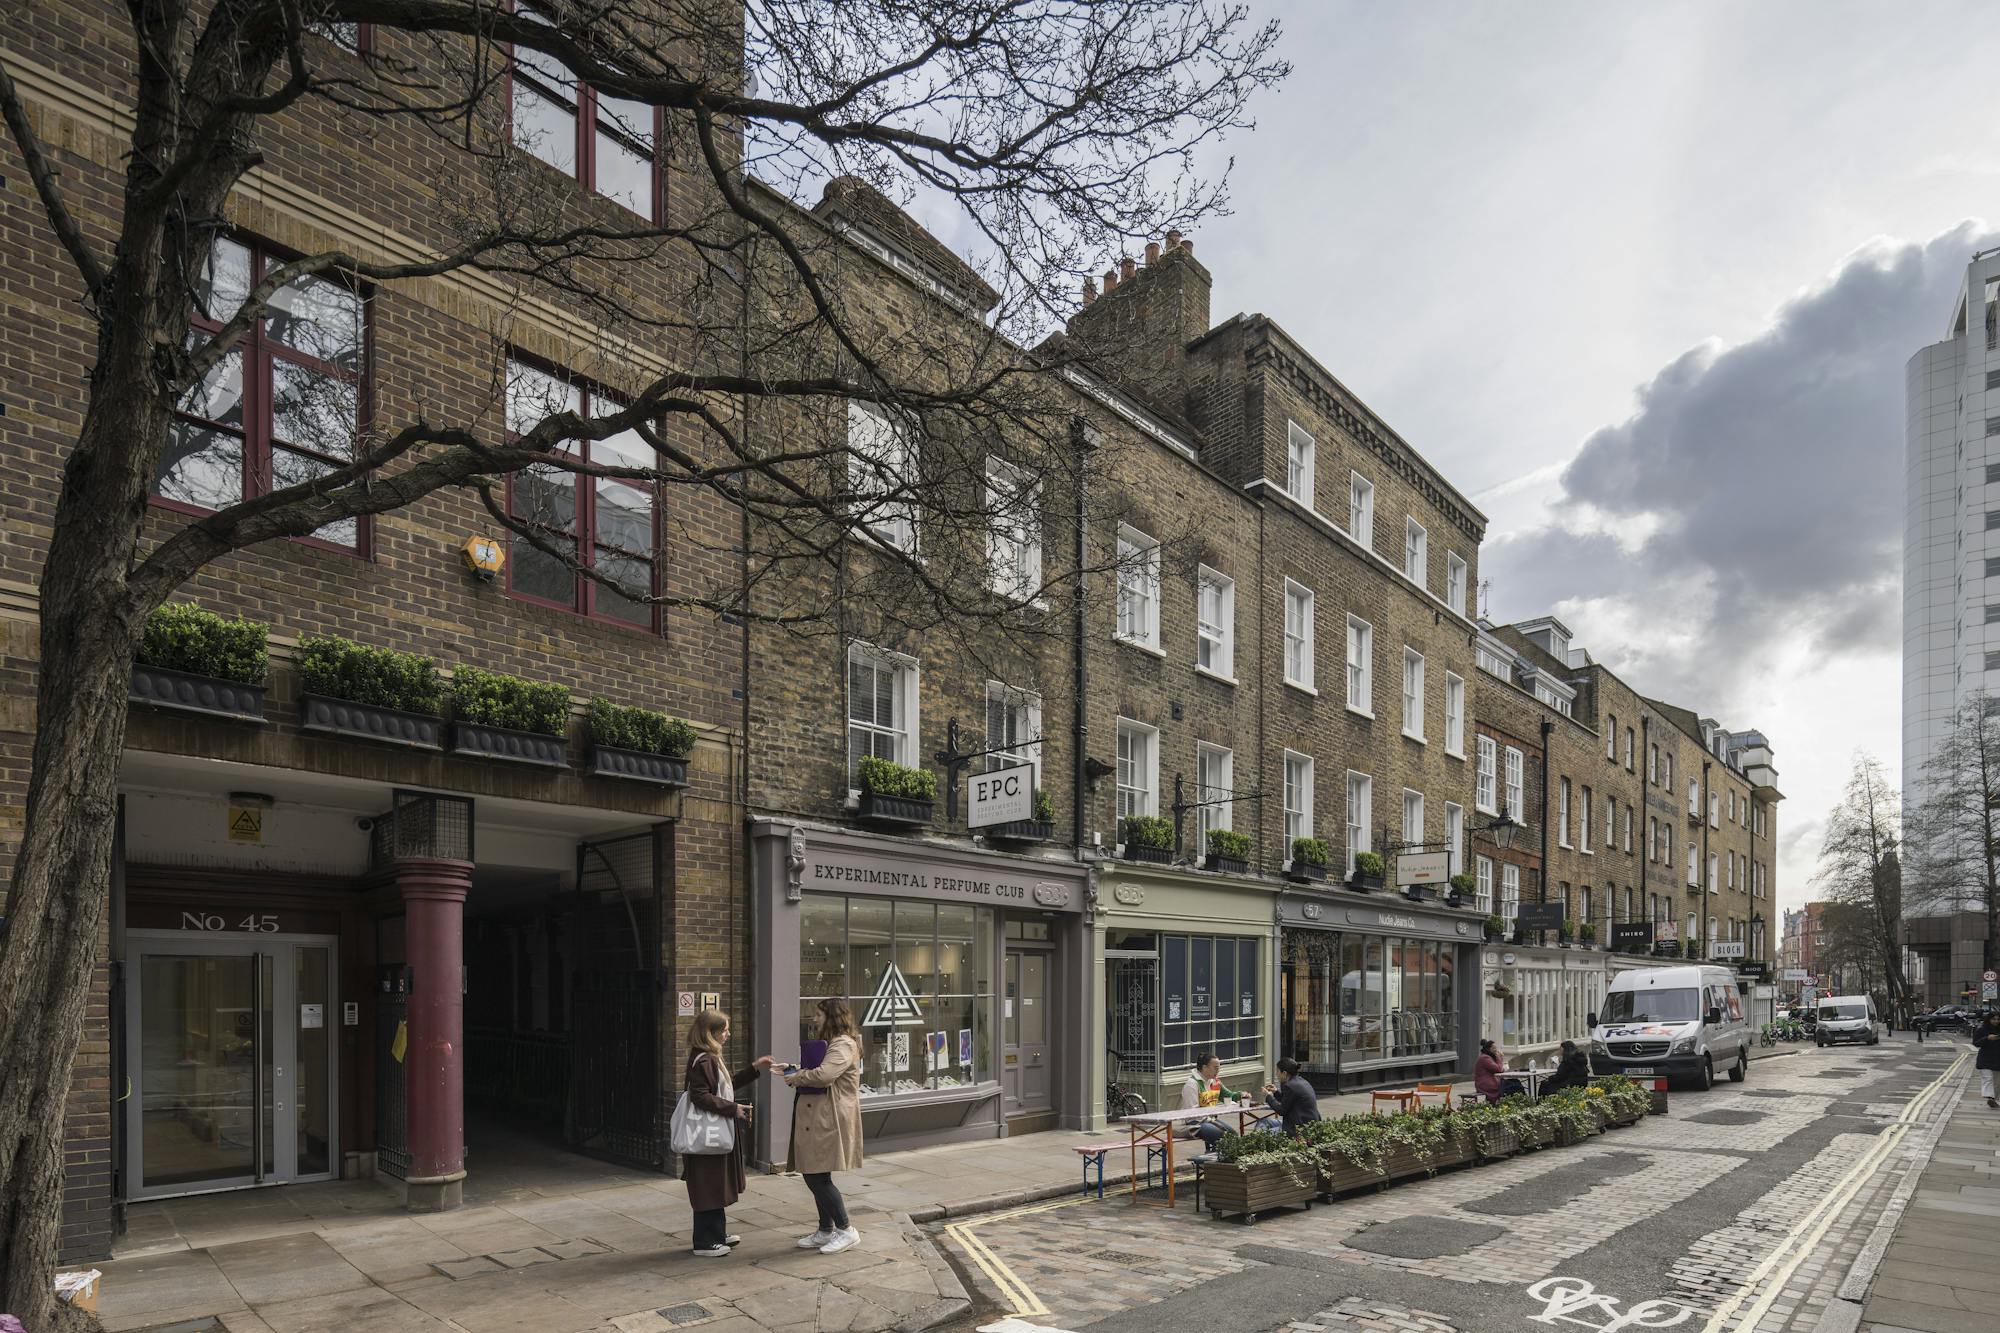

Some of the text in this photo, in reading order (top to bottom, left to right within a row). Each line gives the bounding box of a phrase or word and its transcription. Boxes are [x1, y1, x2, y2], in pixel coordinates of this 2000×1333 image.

[977, 775, 1021, 802] EPC.
[815, 864, 1024, 898] EXPERIMENTAL PERFUME CLUB
[1045, 886, 1061, 903] 53
[1123, 886, 1139, 902] 55
[1308, 904, 1319, 917] 57
[238, 913, 280, 933] 45
[1378, 912, 1393, 926] Nudie
[1717, 945, 1741, 955] BLOCH
[704, 995, 717, 1011] H
[1605, 1025, 1675, 1039] FedEx
[686, 1124, 720, 1147] VE
